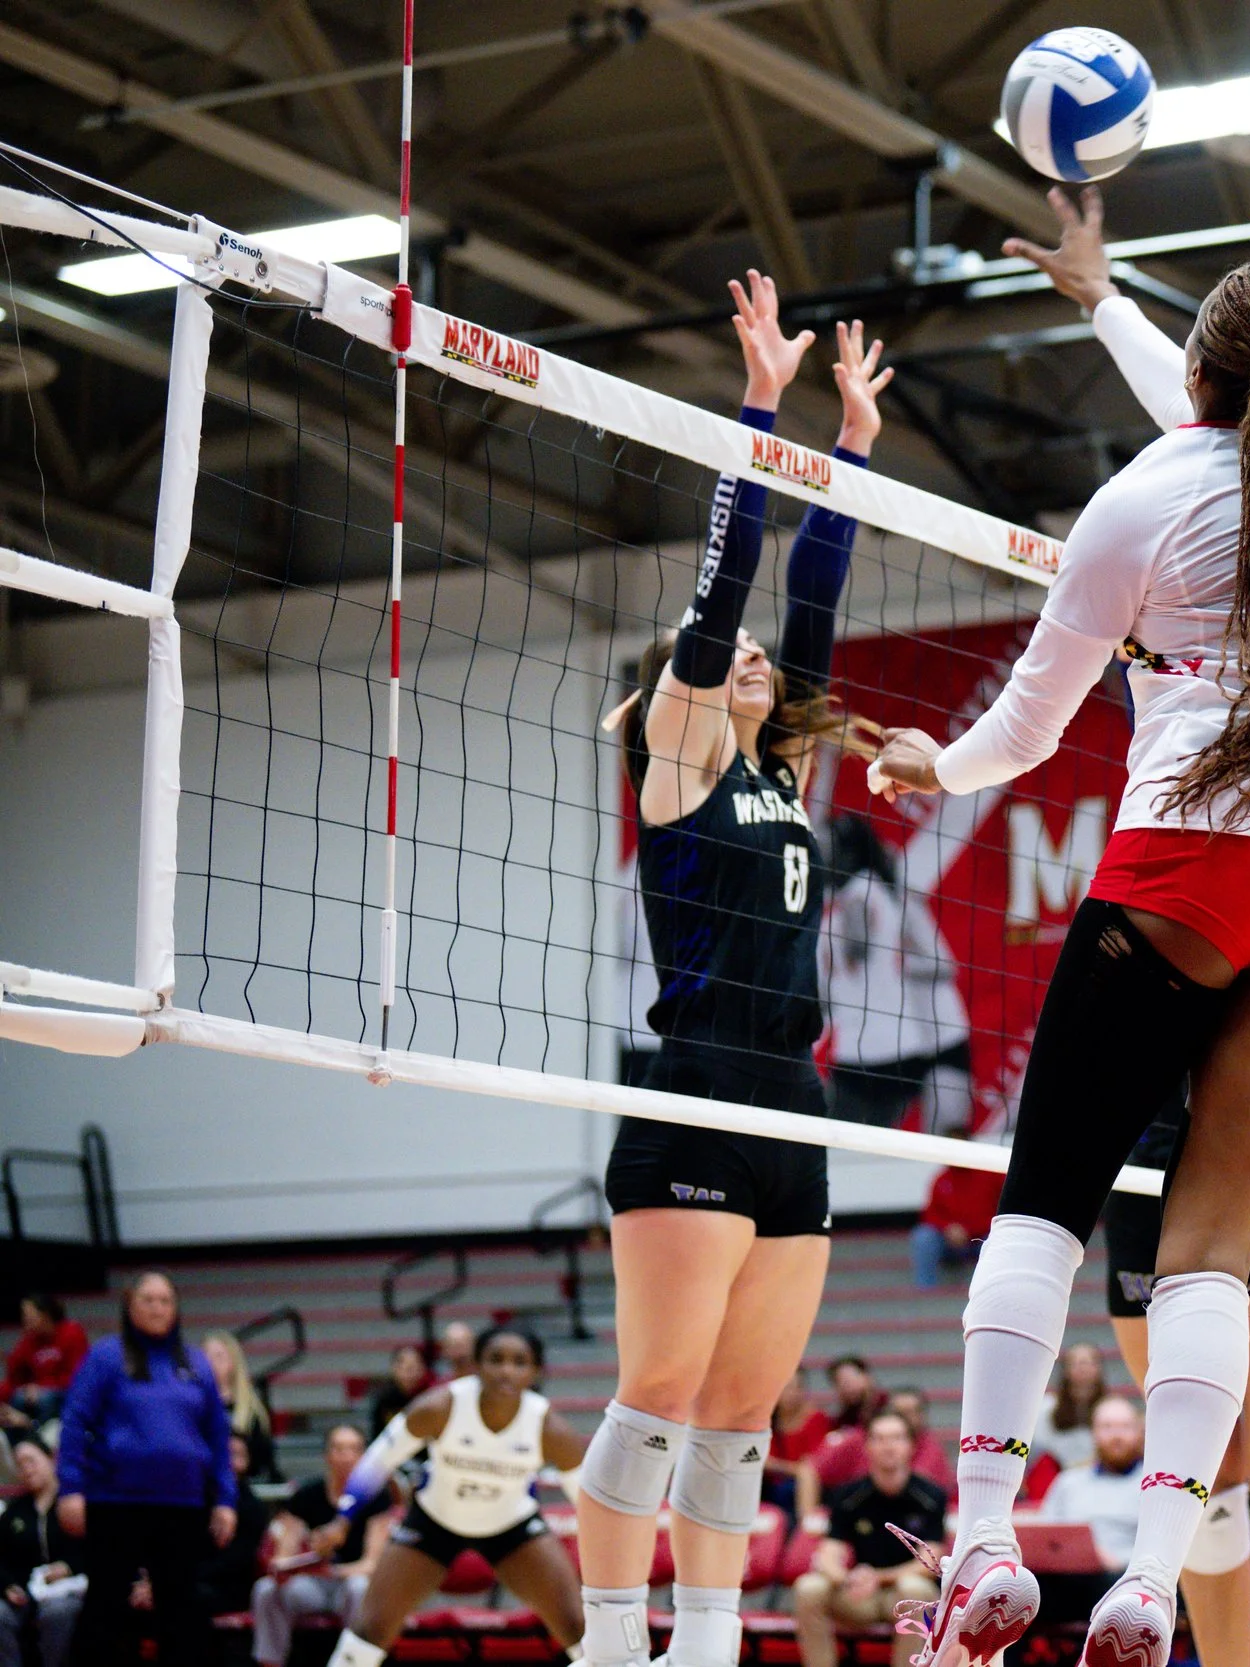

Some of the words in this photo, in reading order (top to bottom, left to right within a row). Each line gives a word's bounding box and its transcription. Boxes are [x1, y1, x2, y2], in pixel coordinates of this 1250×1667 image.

[229, 238, 263, 260] Senoh
[360, 295, 385, 311] sports
[443, 316, 541, 381] MARYLAND
[752, 431, 831, 486] MARYLAND
[1004, 796, 1107, 927] M
